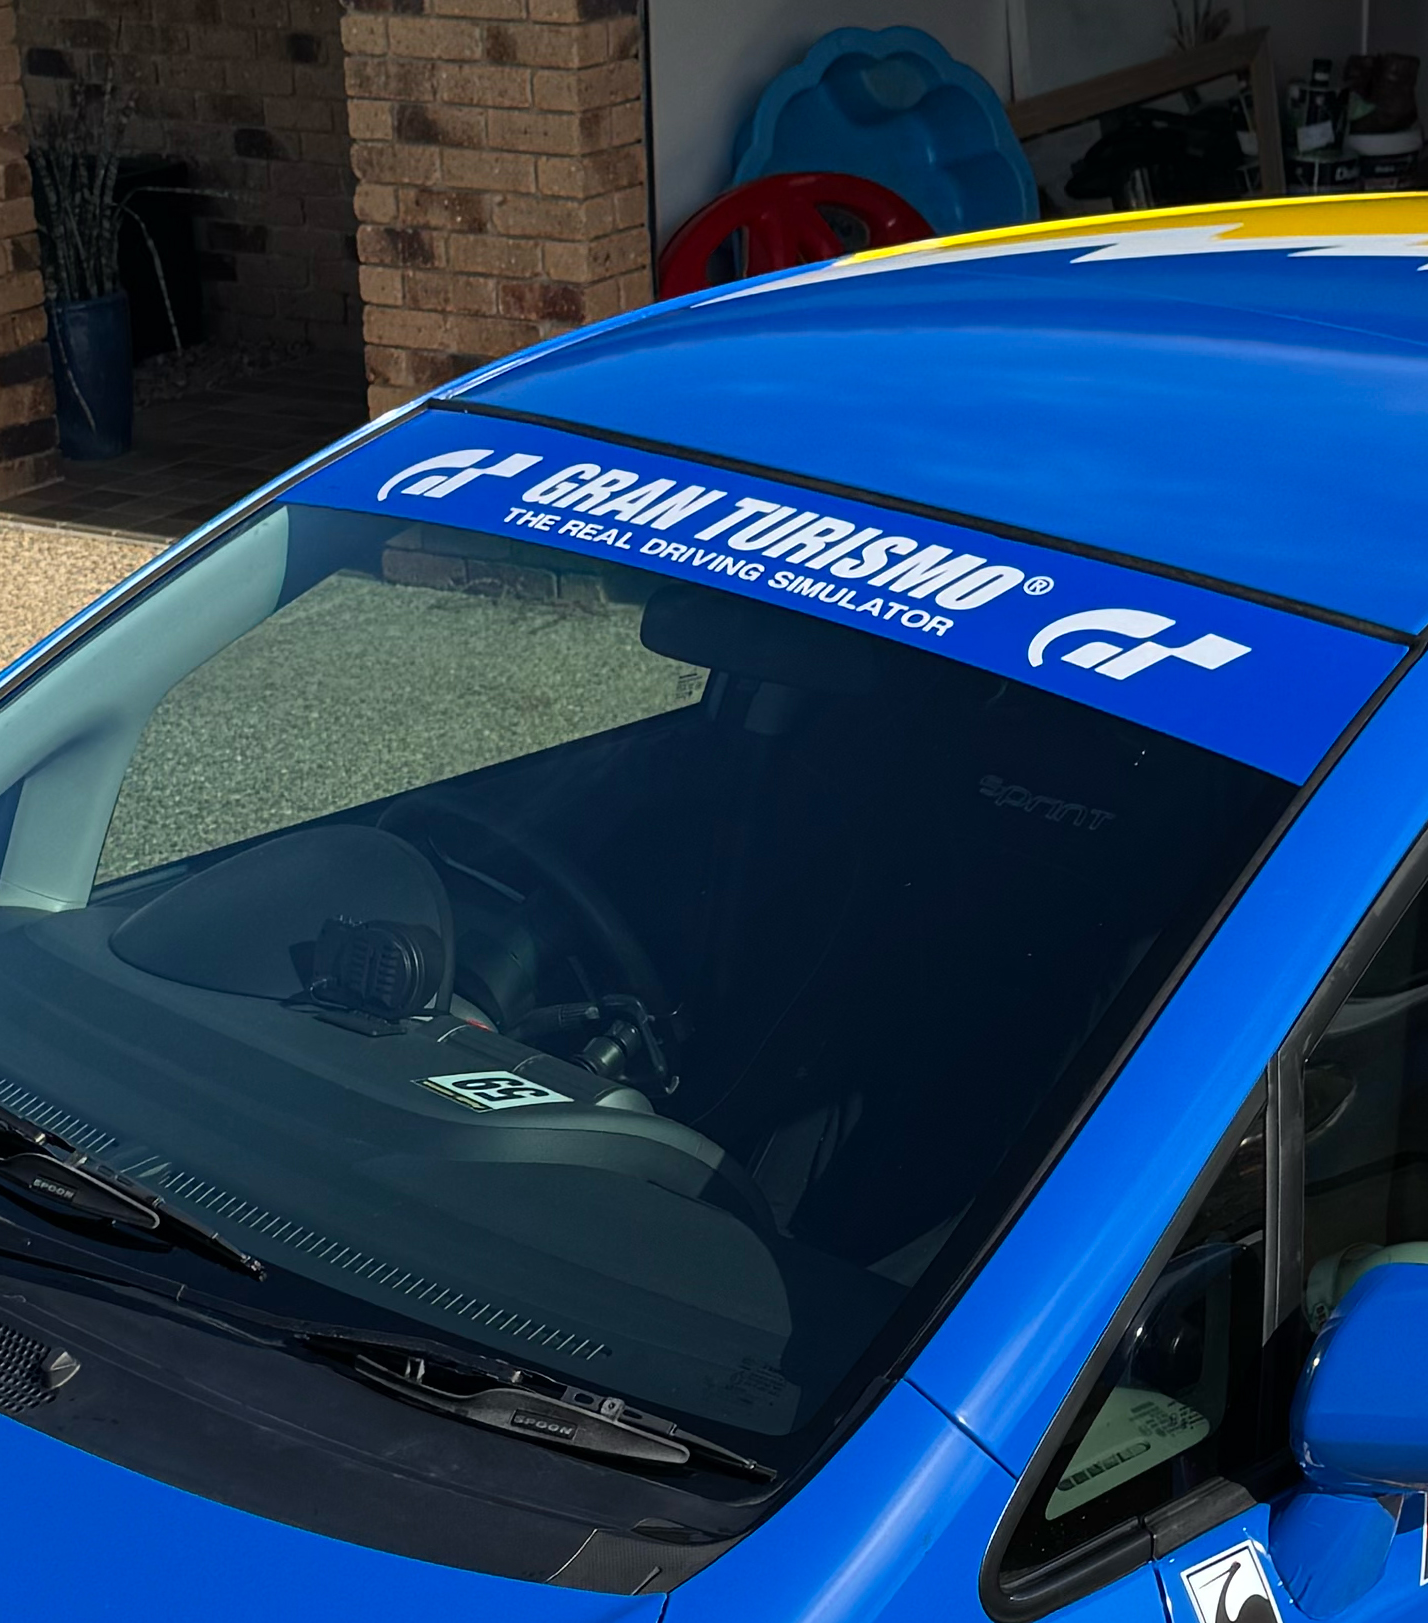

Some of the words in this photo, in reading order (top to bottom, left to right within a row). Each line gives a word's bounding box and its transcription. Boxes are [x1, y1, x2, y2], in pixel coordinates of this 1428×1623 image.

[521, 462, 727, 530] GRAN
[503, 507, 562, 536] THE
[562, 518, 633, 551] REAL
[638, 537, 764, 582] DRIVING
[767, 569, 955, 638] SIMULATOR
[32, 1177, 76, 1200] SPOON
[513, 1414, 573, 1435] SPOON
